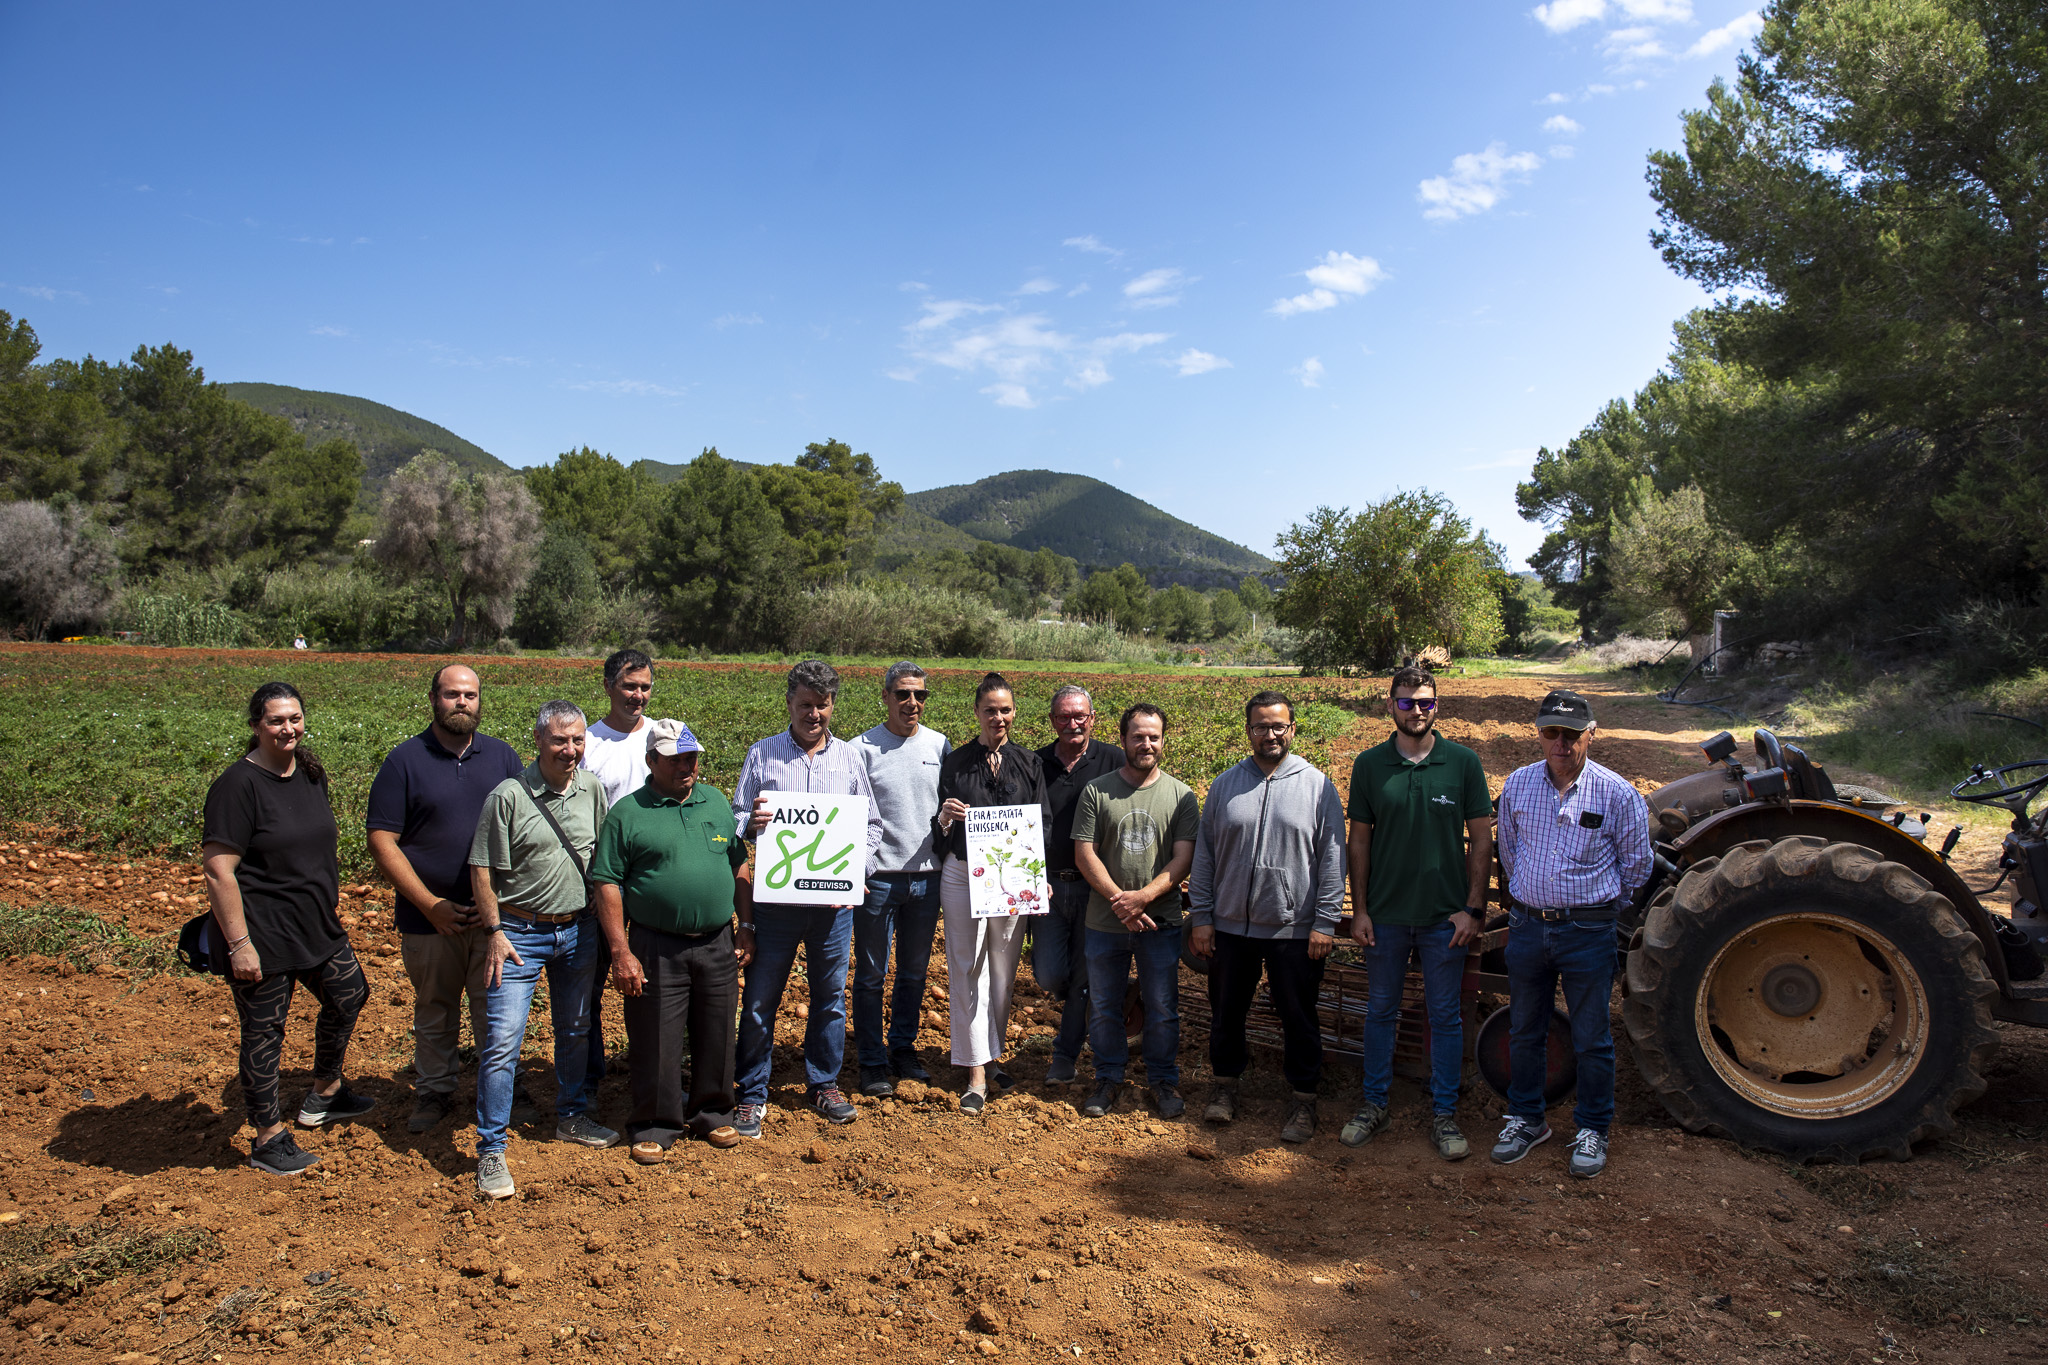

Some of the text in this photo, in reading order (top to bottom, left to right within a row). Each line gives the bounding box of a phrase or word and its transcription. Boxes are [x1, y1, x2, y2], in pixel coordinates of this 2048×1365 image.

[773, 805, 819, 825] AIXÒ
[973, 810, 991, 820] FIRA
[998, 808, 1023, 819] PATATA
[968, 822, 1009, 832] EIVISSENCA
[798, 879, 850, 890] ÉS D'EIVISSA
